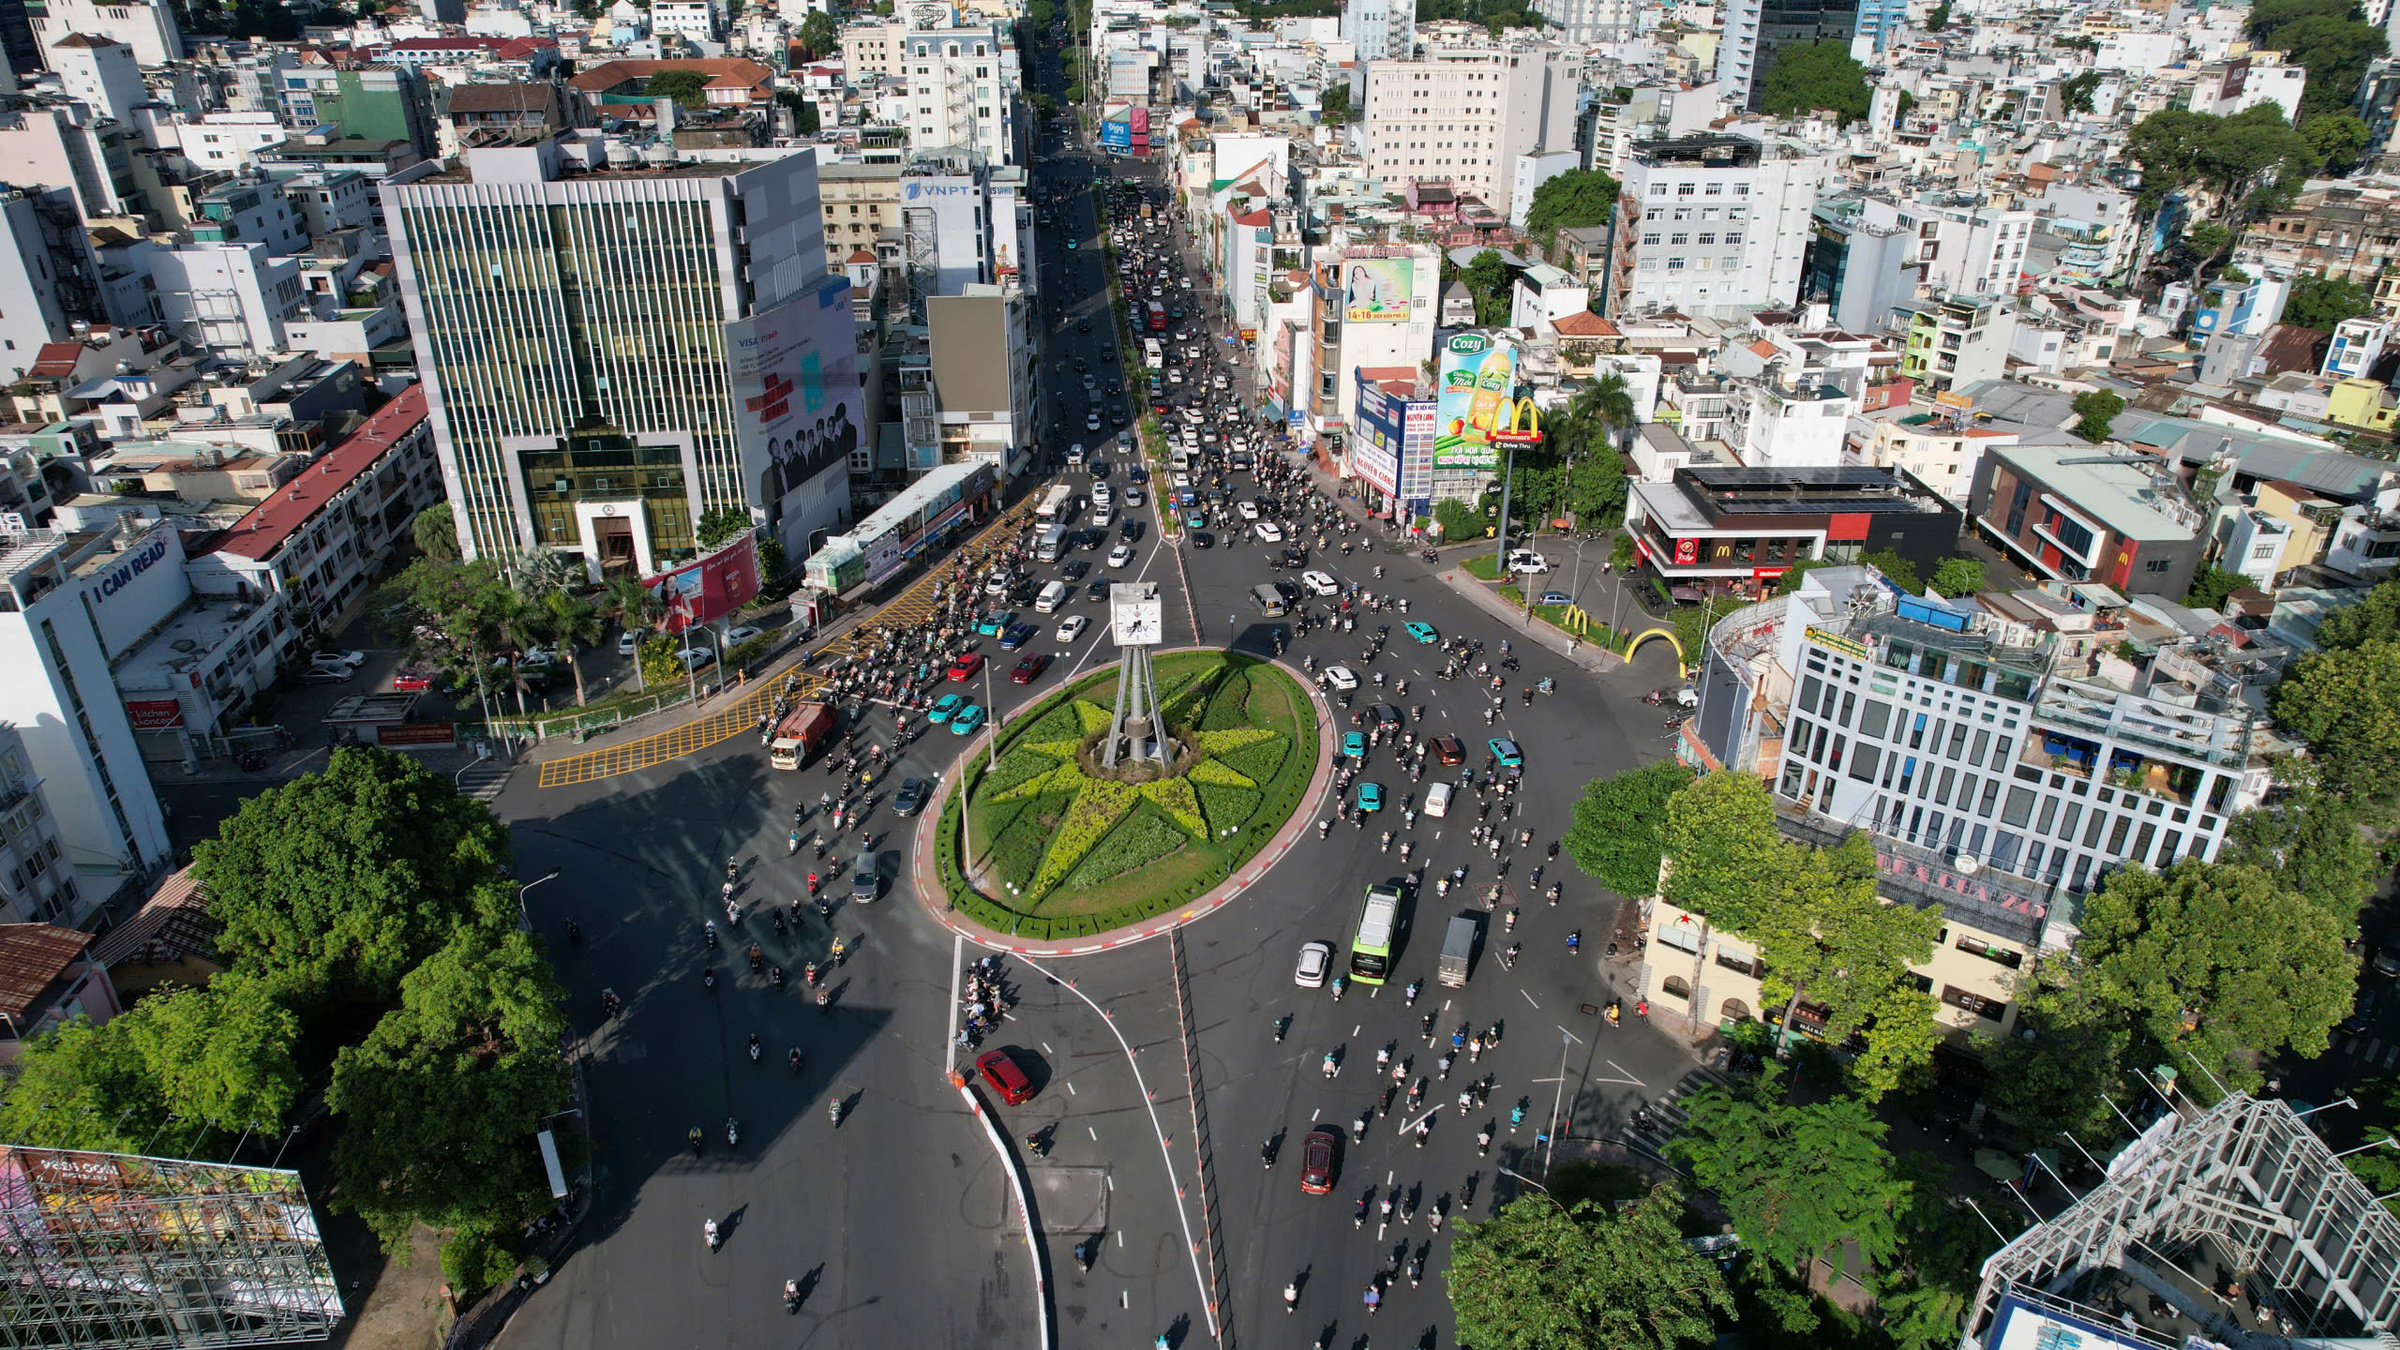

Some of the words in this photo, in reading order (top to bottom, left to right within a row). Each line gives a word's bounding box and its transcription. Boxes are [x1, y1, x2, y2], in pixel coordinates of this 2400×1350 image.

[924, 186, 969, 196] VNPT
[1347, 310, 1372, 320] 14-16
[739, 337, 759, 348] VISA
[1452, 337, 1482, 352] Cozy
[1481, 379, 1501, 391] Cozy
[1438, 456, 1454, 464] NGON
[1378, 471, 1394, 488] GIANG
[93, 586, 103, 604] I
[102, 565, 132, 597] CAN
[131, 541, 166, 577] READ
[1126, 625, 1149, 634] BDV
[135, 708, 170, 718] kitchen
[1914, 866, 1930, 884] &
[1938, 872, 1988, 903] CUA
